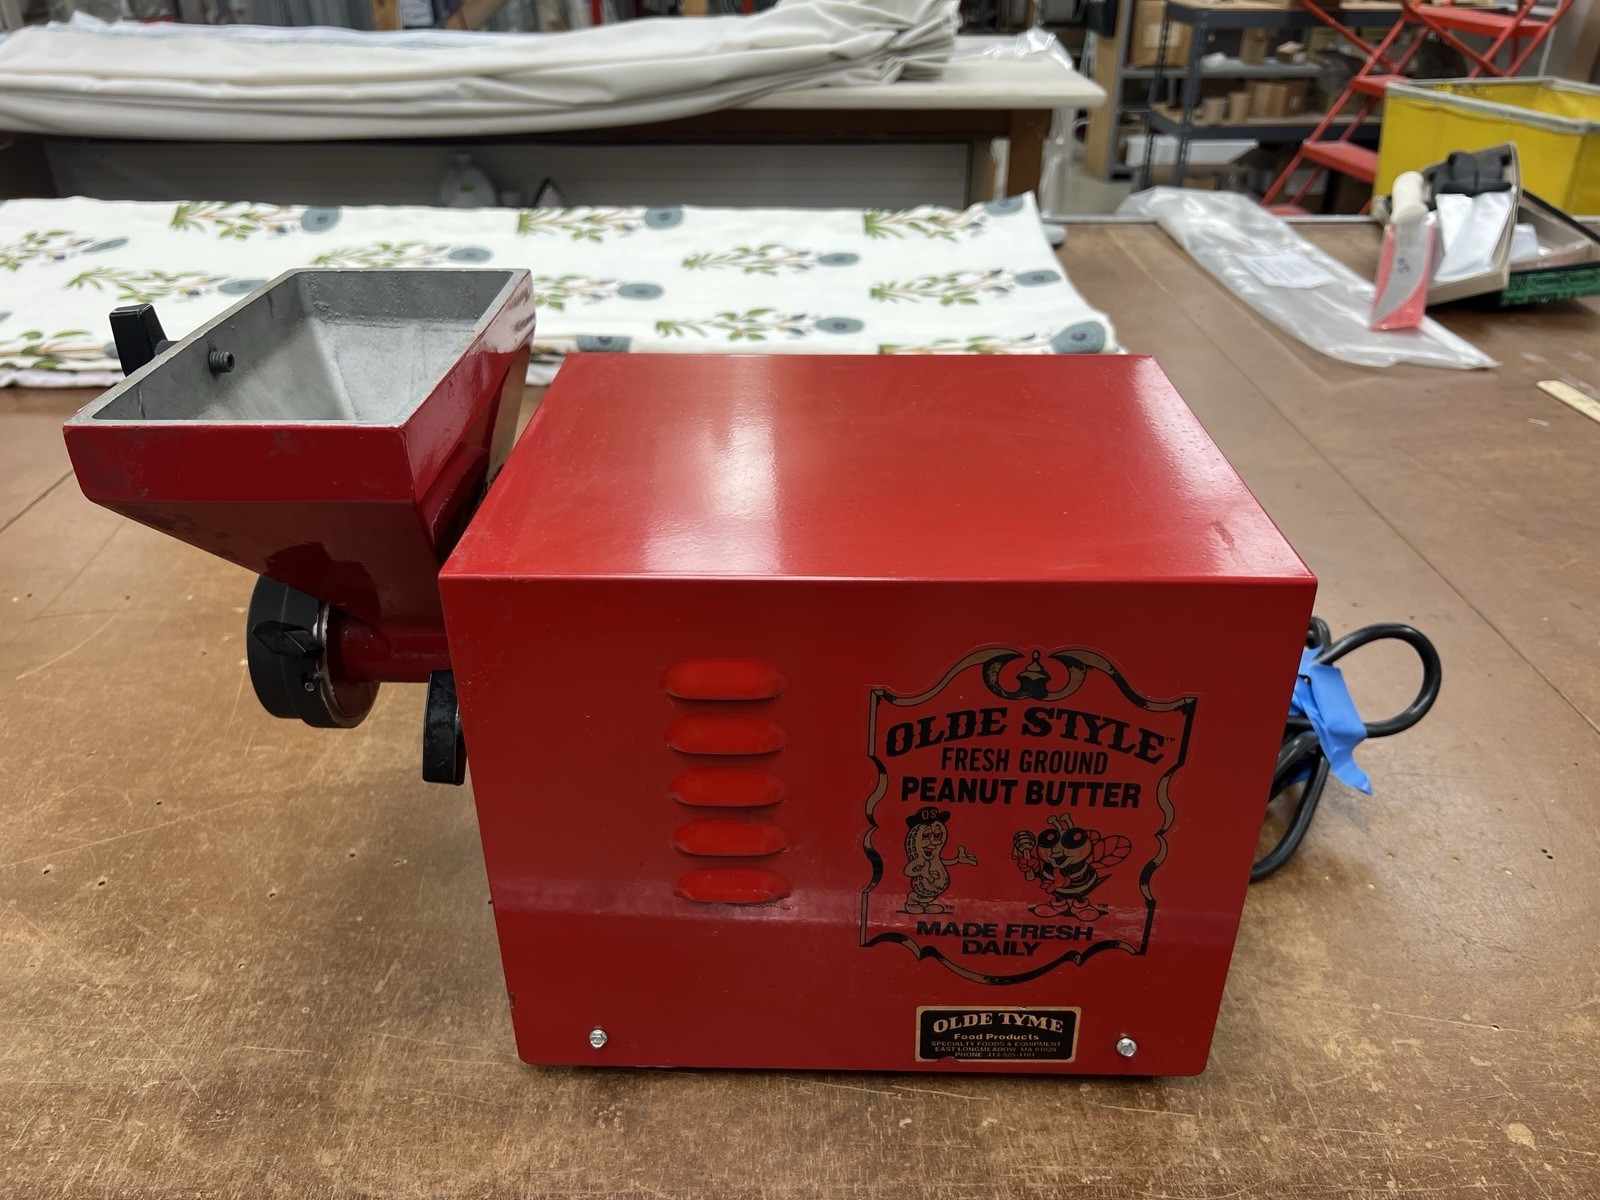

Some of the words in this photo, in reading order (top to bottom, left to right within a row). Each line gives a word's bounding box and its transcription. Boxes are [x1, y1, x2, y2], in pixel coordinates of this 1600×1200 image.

[885, 707, 1008, 757] OLDE
[1021, 706, 1166, 764] STYLE
[941, 747, 1010, 772] FRESH
[1019, 749, 1108, 775] GROUND
[901, 776, 1018, 804] PEANUT
[1025, 780, 1141, 808] BUTTER
[916, 921, 998, 938] MADE
[1005, 923, 1093, 941] FRESH
[961, 940, 1041, 956] DAILY
[933, 1012, 993, 1033] OLDE
[998, 1012, 1064, 1033] TYME
